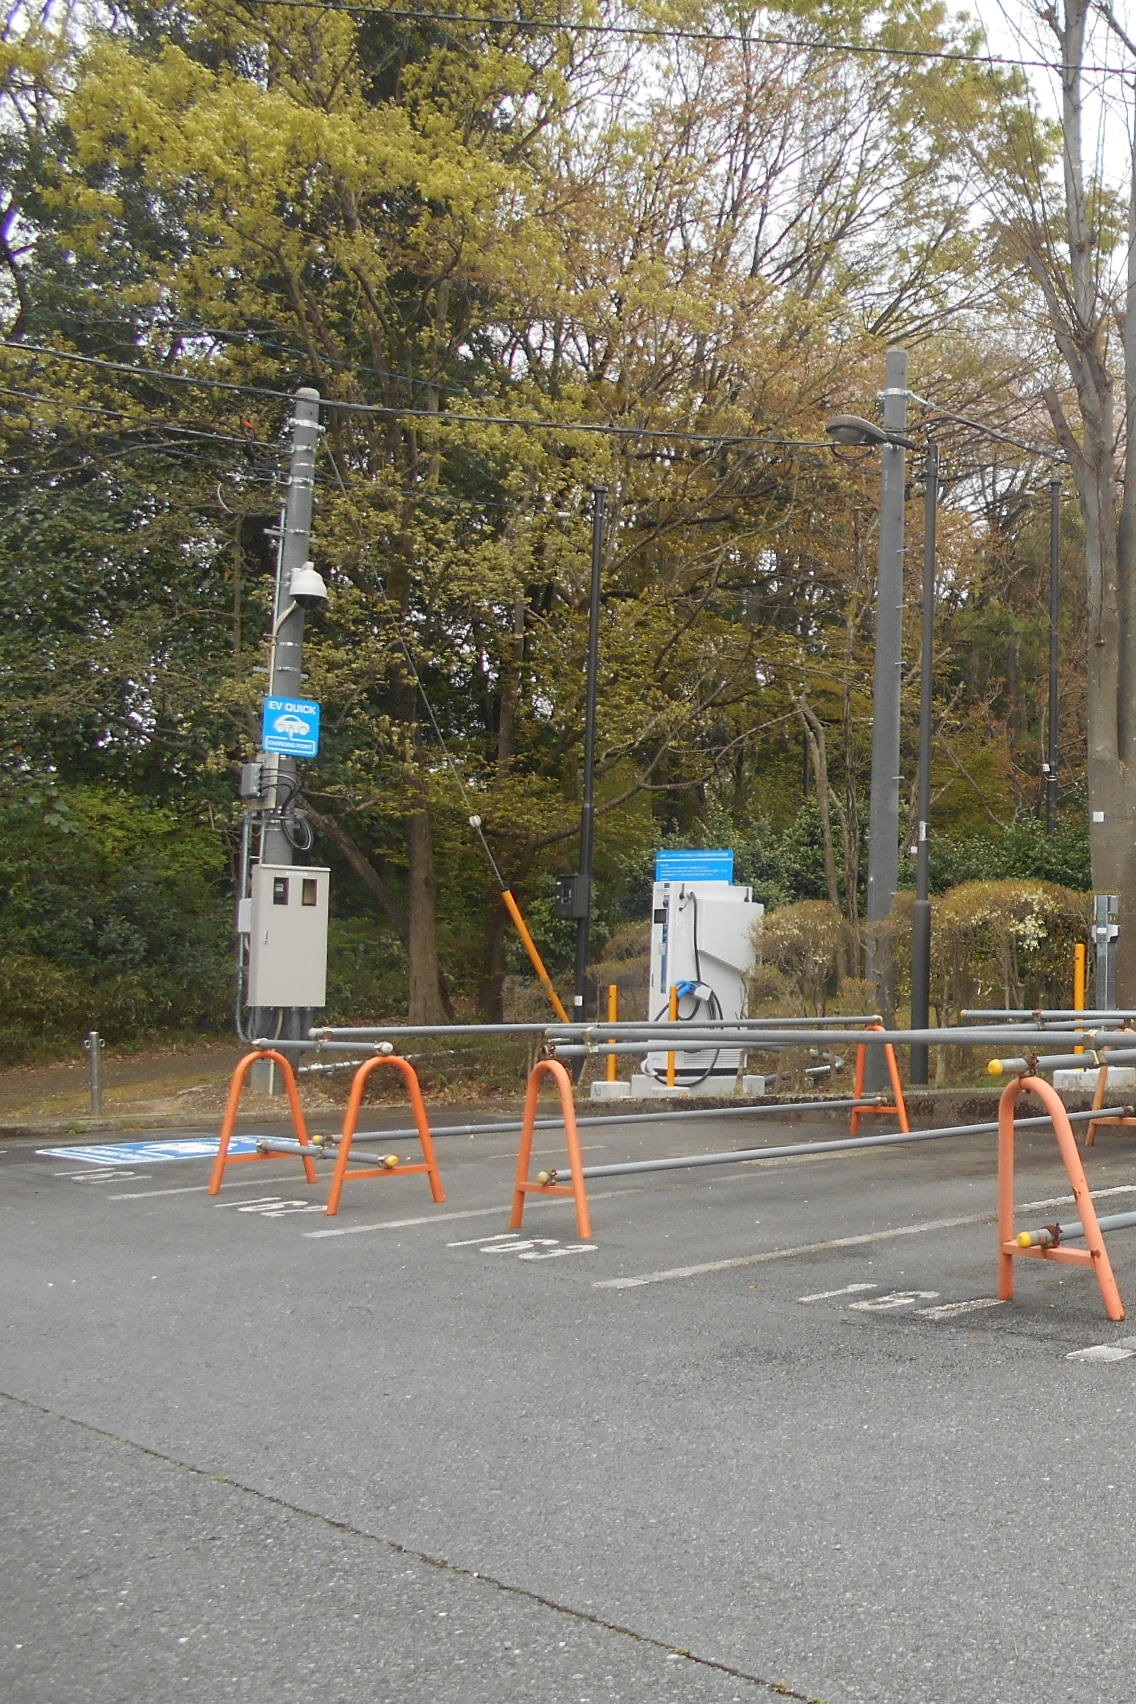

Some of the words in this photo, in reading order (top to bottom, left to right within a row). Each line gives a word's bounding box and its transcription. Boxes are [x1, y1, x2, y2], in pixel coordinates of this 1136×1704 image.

[269, 701, 283, 710] EV
[286, 703, 316, 714] QUICK
[445, 1233, 599, 1259] 163
